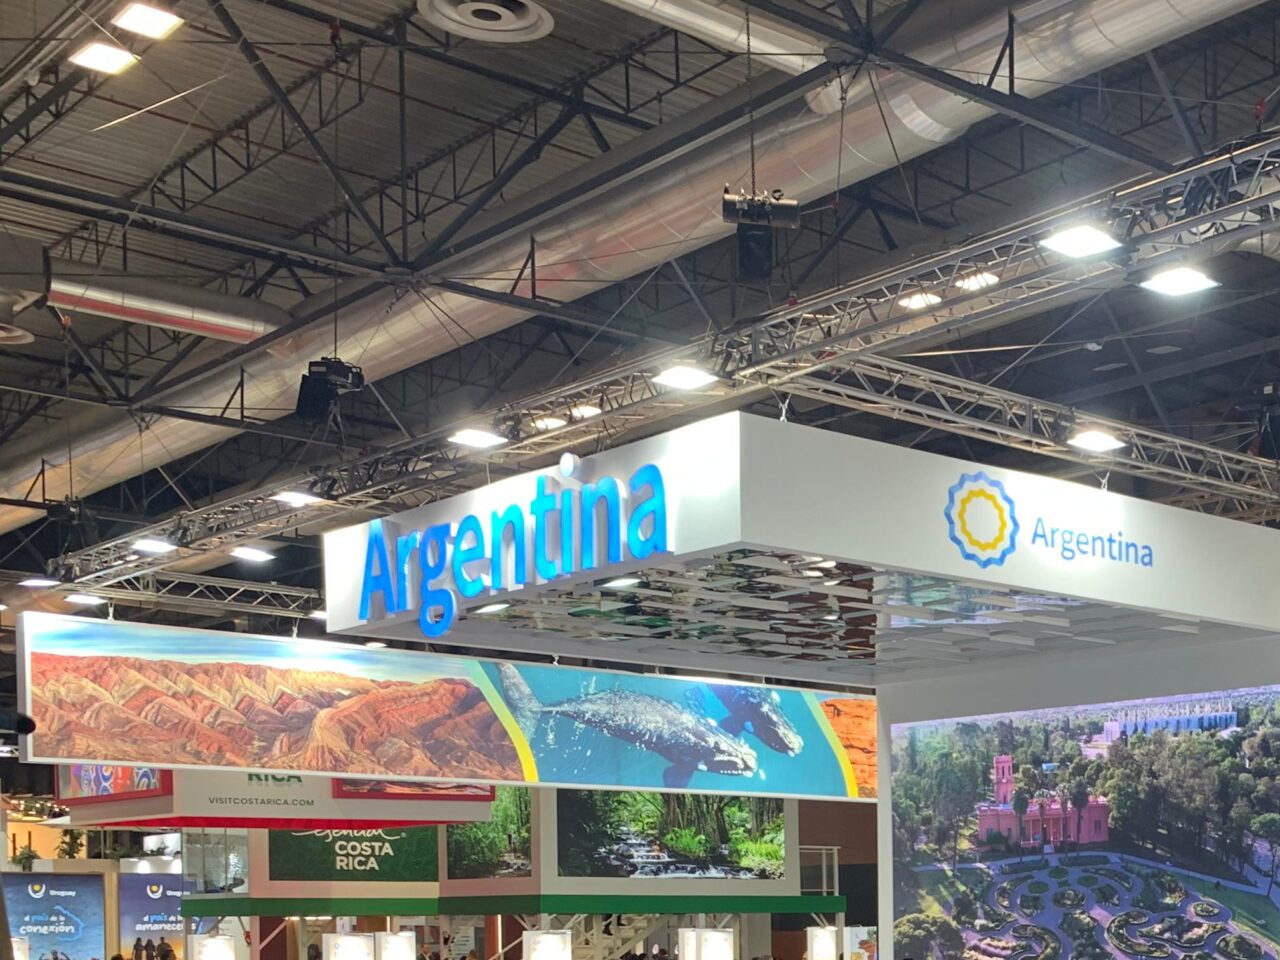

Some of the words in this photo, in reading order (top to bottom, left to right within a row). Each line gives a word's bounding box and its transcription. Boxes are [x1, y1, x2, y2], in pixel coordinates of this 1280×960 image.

[358, 452, 668, 638] Argentina
[1031, 517, 1154, 567] Argentina
[208, 797, 315, 806] VISITCOSTARICA.COM
[335, 841, 394, 856] COSTA
[336, 856, 380, 870] RICA
[19, 921, 75, 934] conexión
